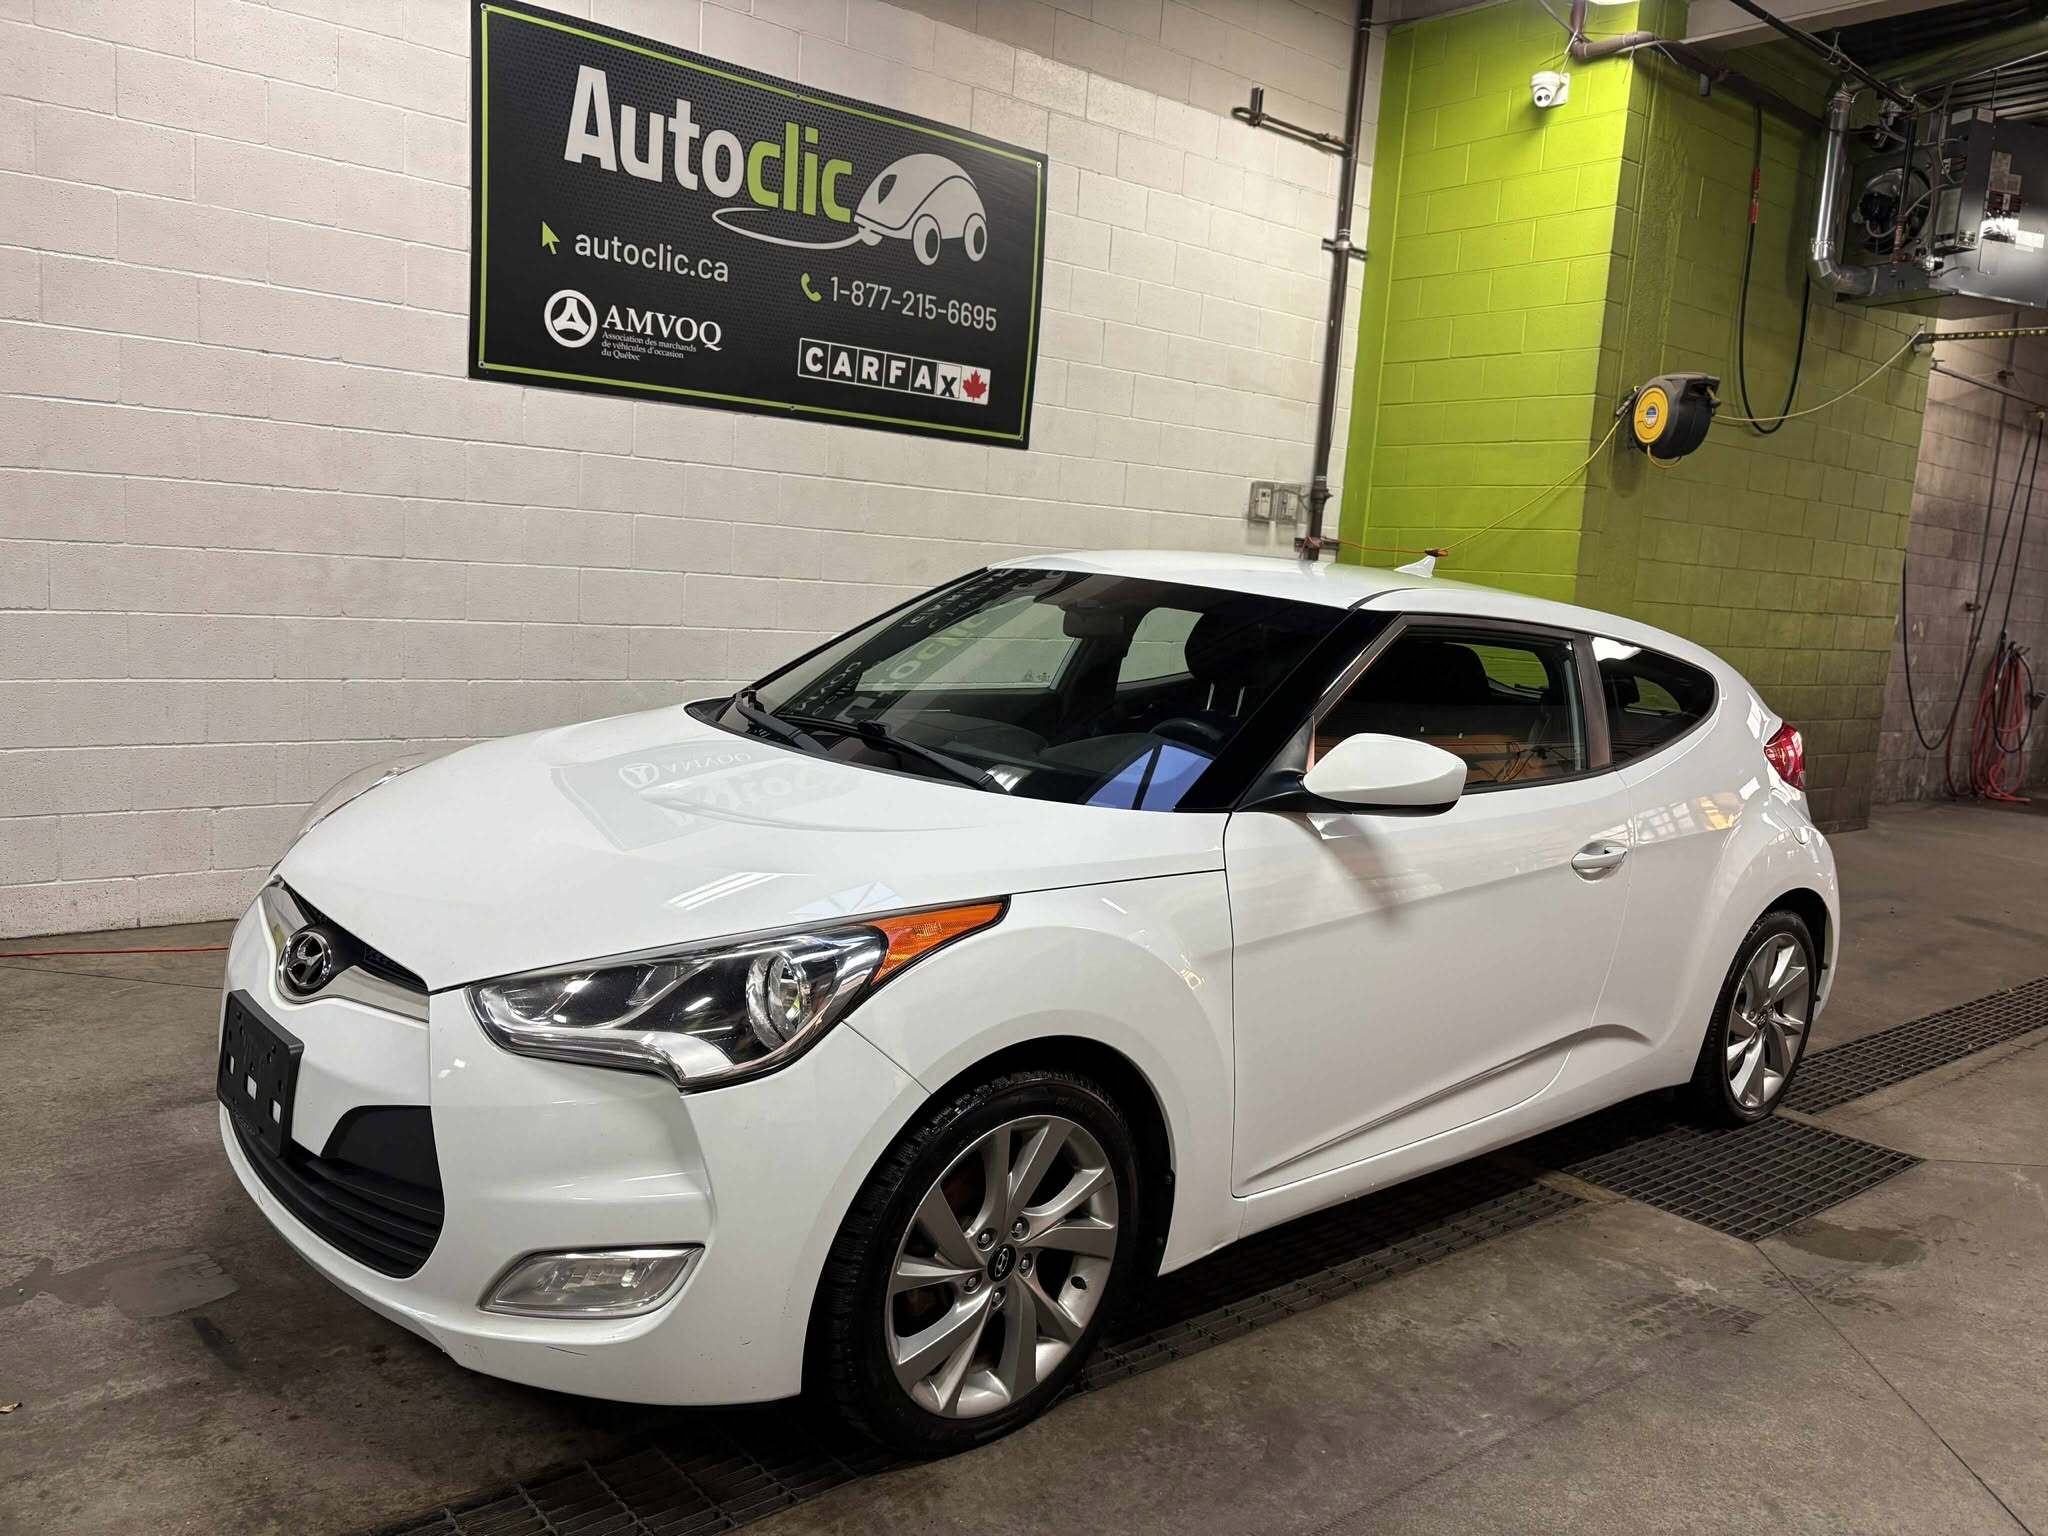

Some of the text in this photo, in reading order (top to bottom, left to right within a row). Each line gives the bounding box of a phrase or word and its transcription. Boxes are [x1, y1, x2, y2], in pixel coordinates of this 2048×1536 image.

[564, 64, 853, 223] Autoclic
[575, 234, 728, 282] autoclic.ca
[830, 276, 997, 331] 1-877-215-6695
[601, 340, 684, 359] de véhicules d'occasion
[602, 304, 722, 351] AMVOQ
[602, 331, 696, 352] Association des marchands
[601, 348, 641, 360] du Québec
[805, 347, 957, 398] CARFAX
